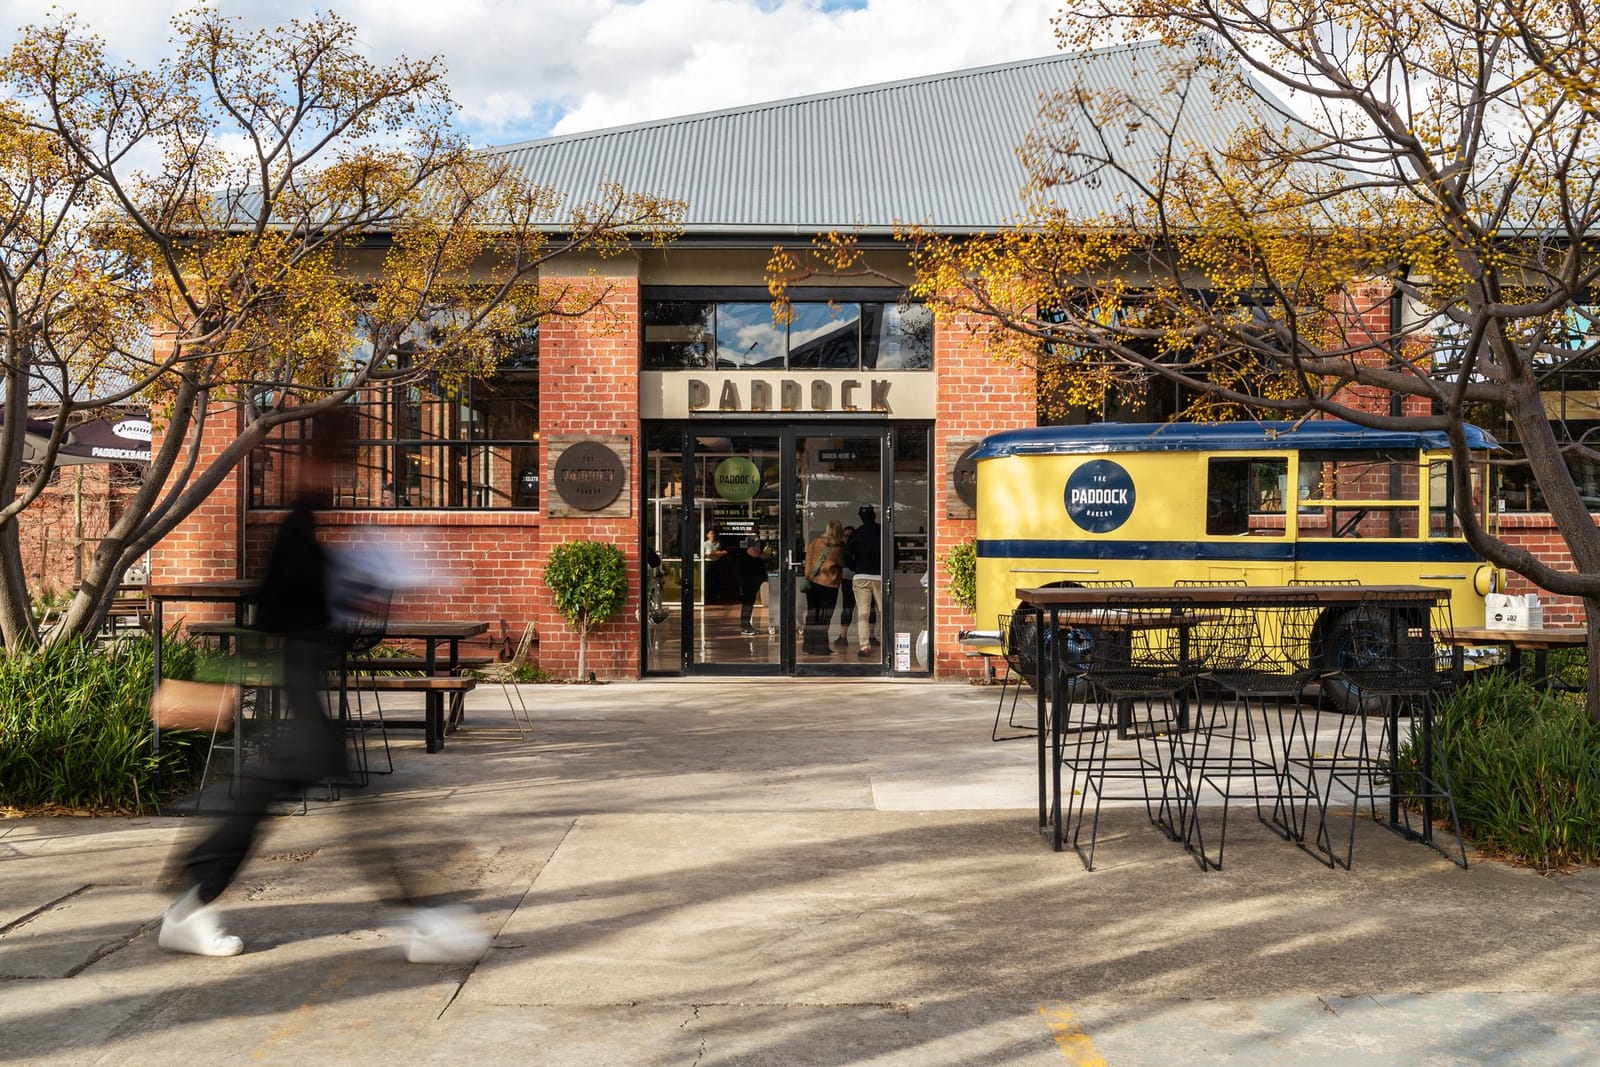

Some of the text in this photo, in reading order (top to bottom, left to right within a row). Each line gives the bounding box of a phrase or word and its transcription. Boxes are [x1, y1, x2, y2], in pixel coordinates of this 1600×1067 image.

[688, 379, 892, 412] PADDOCK
[1071, 488, 1128, 505] PADDOCK
[1086, 509, 1113, 518] BAKERY
